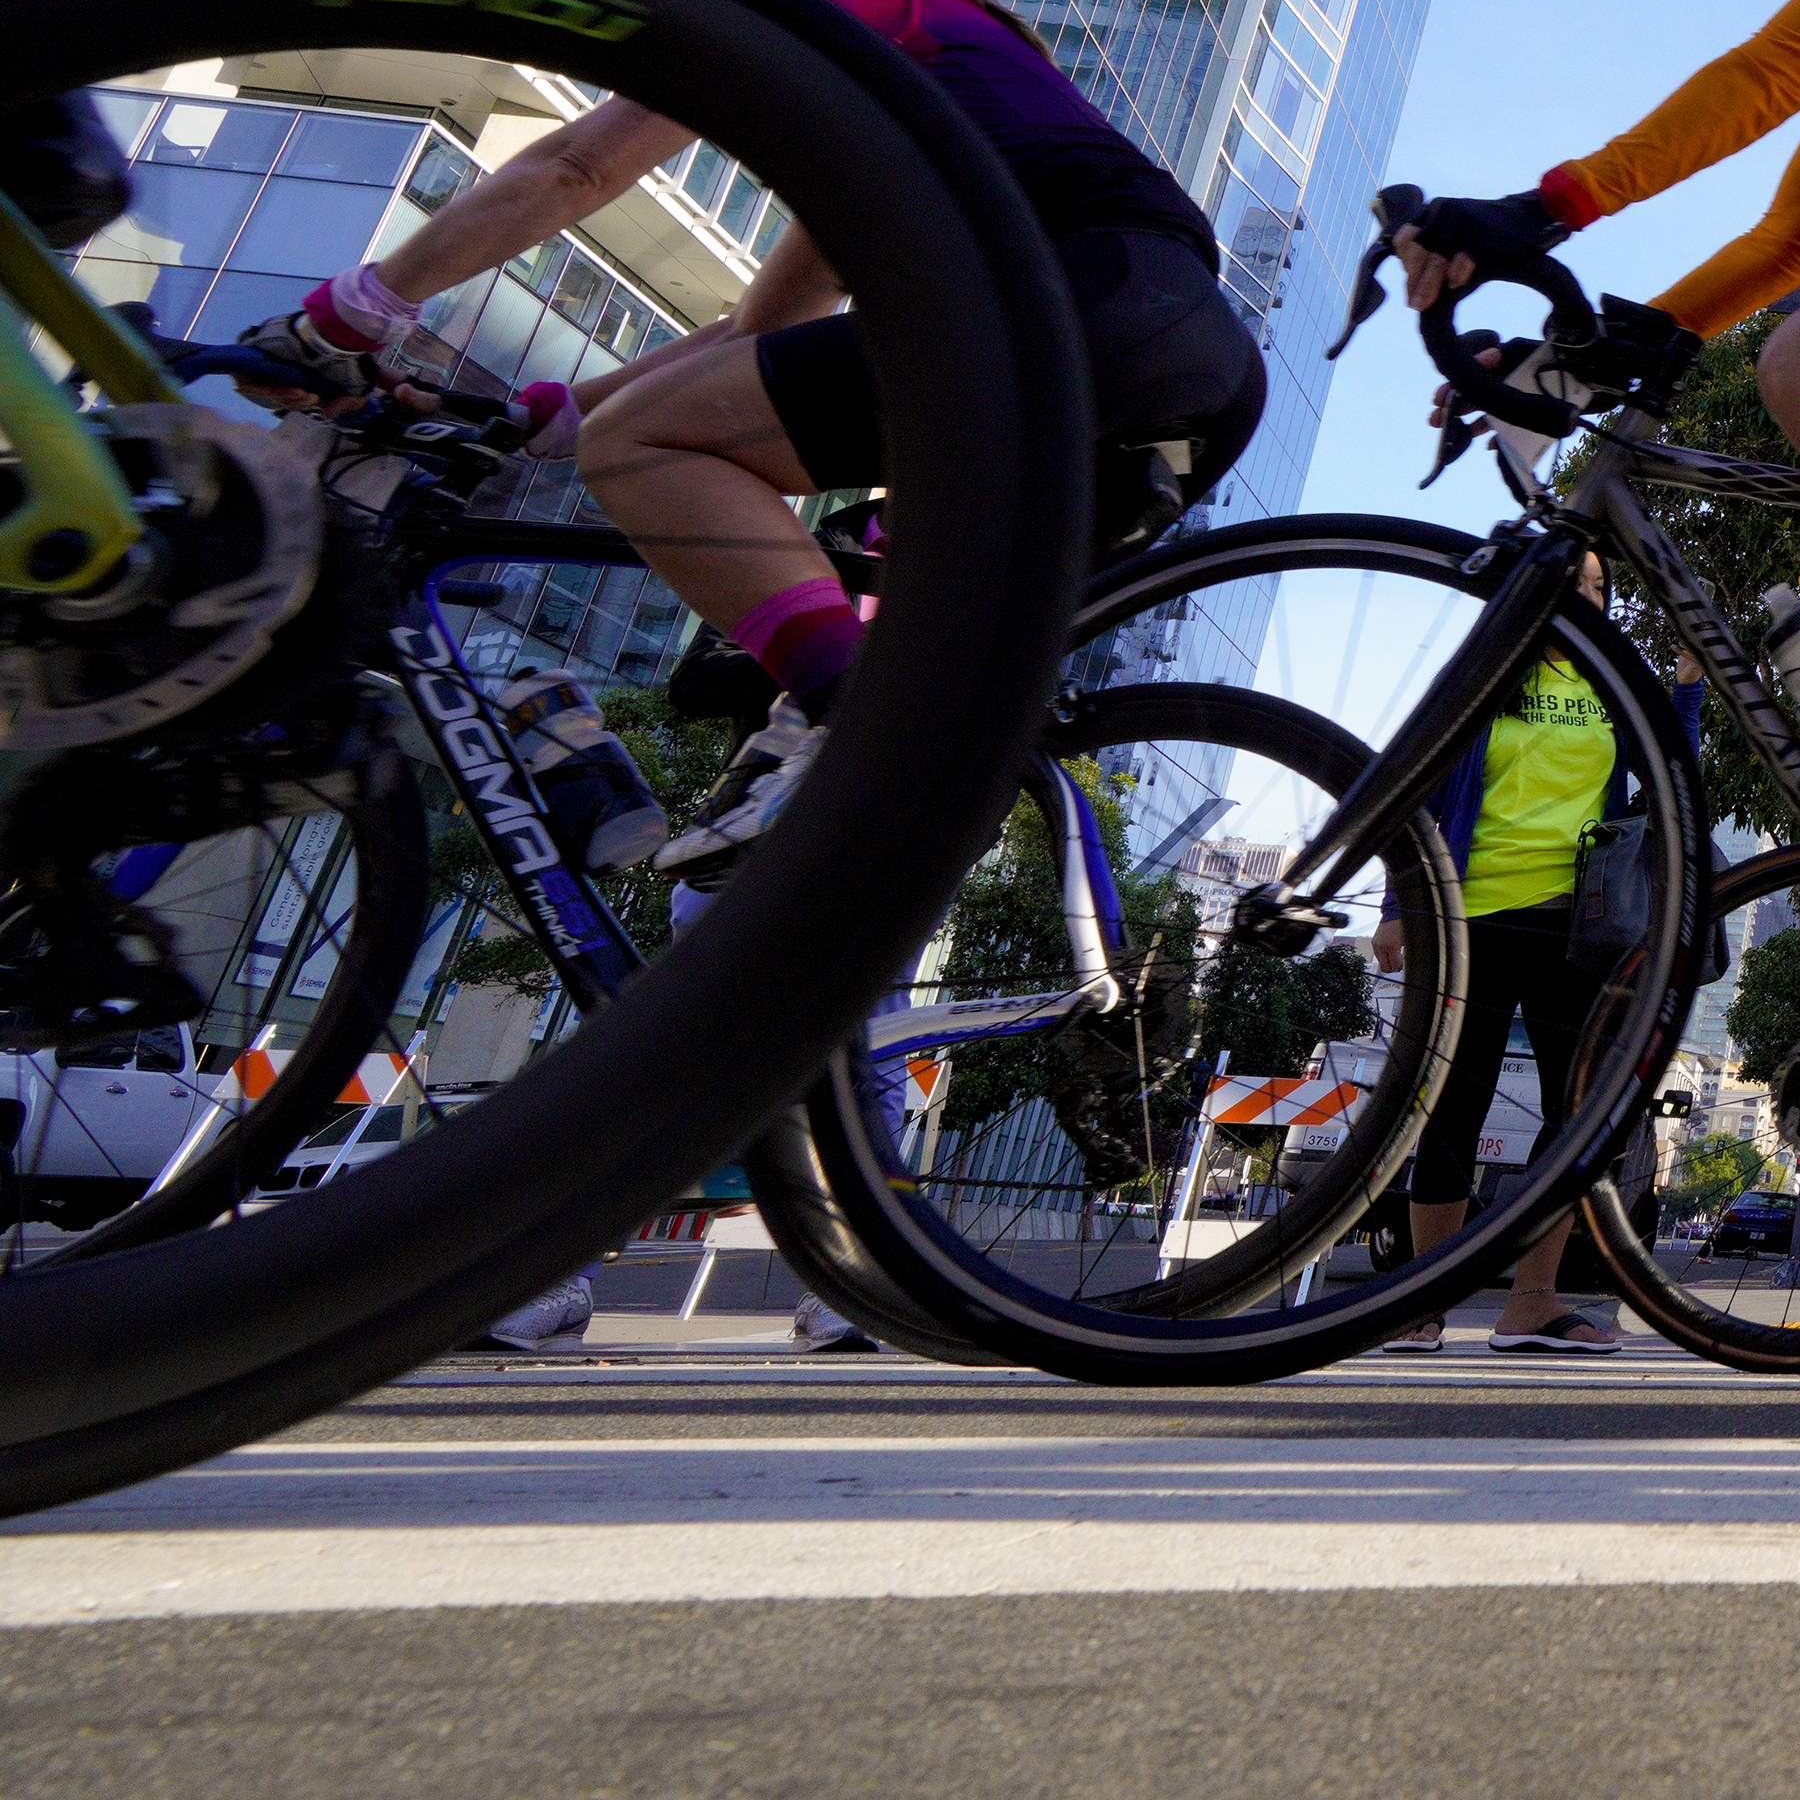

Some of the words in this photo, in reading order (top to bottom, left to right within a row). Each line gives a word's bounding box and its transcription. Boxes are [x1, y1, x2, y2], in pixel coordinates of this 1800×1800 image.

[1550, 713, 1588, 727] CAUSE
[387, 623, 562, 876] DOGMA
[252, 965, 273, 977] SEMPRA
[305, 977, 326, 990] SEMPRA
[1500, 1063, 1524, 1075] ICE
[1308, 1134, 1339, 1148] 3759
